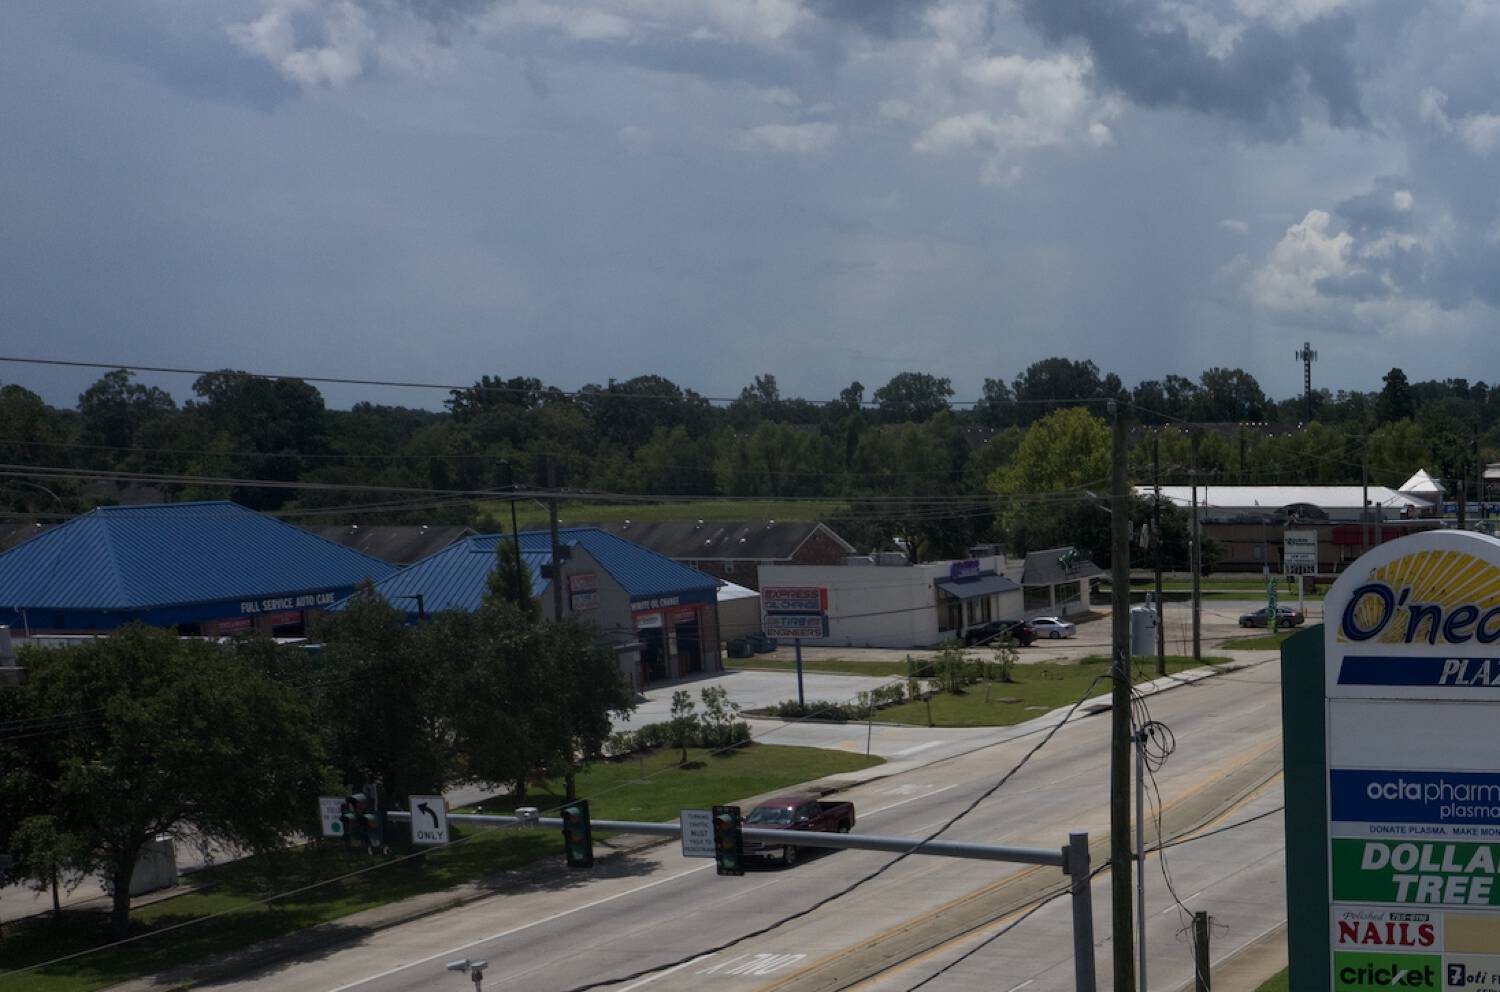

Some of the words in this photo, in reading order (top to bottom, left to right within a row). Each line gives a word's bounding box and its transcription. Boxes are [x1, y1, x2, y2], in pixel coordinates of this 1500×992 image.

[240, 601, 260, 613] FULL
[262, 597, 294, 611] SERVICE
[296, 595, 314, 608] AUTO
[316, 593, 335, 605] CARE
[1440, 803, 1500, 820] plasma
[417, 831, 444, 841] ONLY
[1369, 825, 1406, 834] DONATE
[1409, 826, 1448, 835] PLASMA.
[1452, 827, 1478, 836] MAKE
[1392, 873, 1494, 904] TREE
[1338, 921, 1435, 947] NAILS
[1340, 962, 1435, 987] cricket
